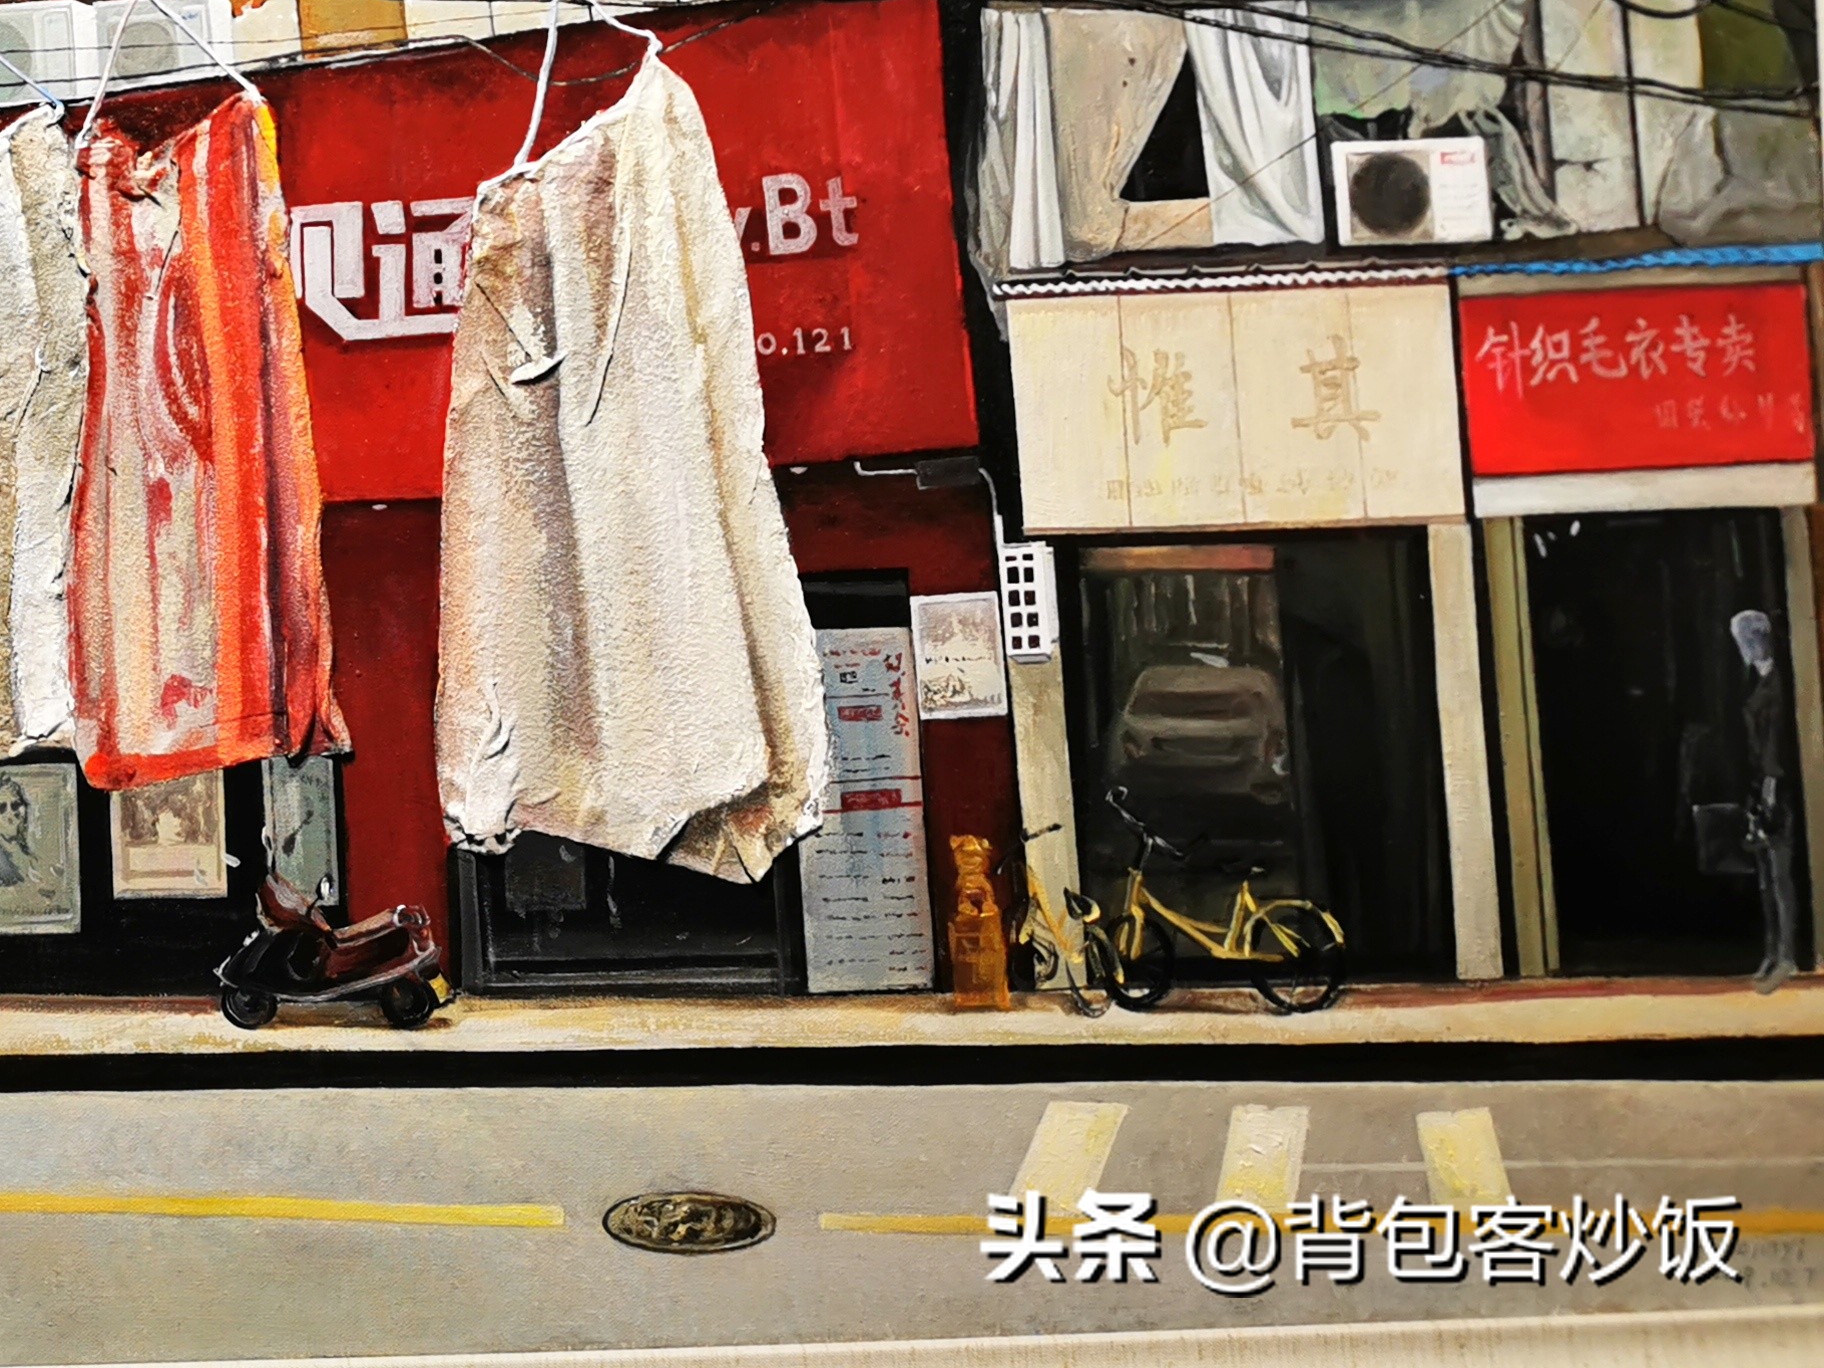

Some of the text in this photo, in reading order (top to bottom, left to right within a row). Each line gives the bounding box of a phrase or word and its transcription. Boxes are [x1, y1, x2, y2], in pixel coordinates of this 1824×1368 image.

[1475, 314, 1756, 399] 针织毛衣专卖
